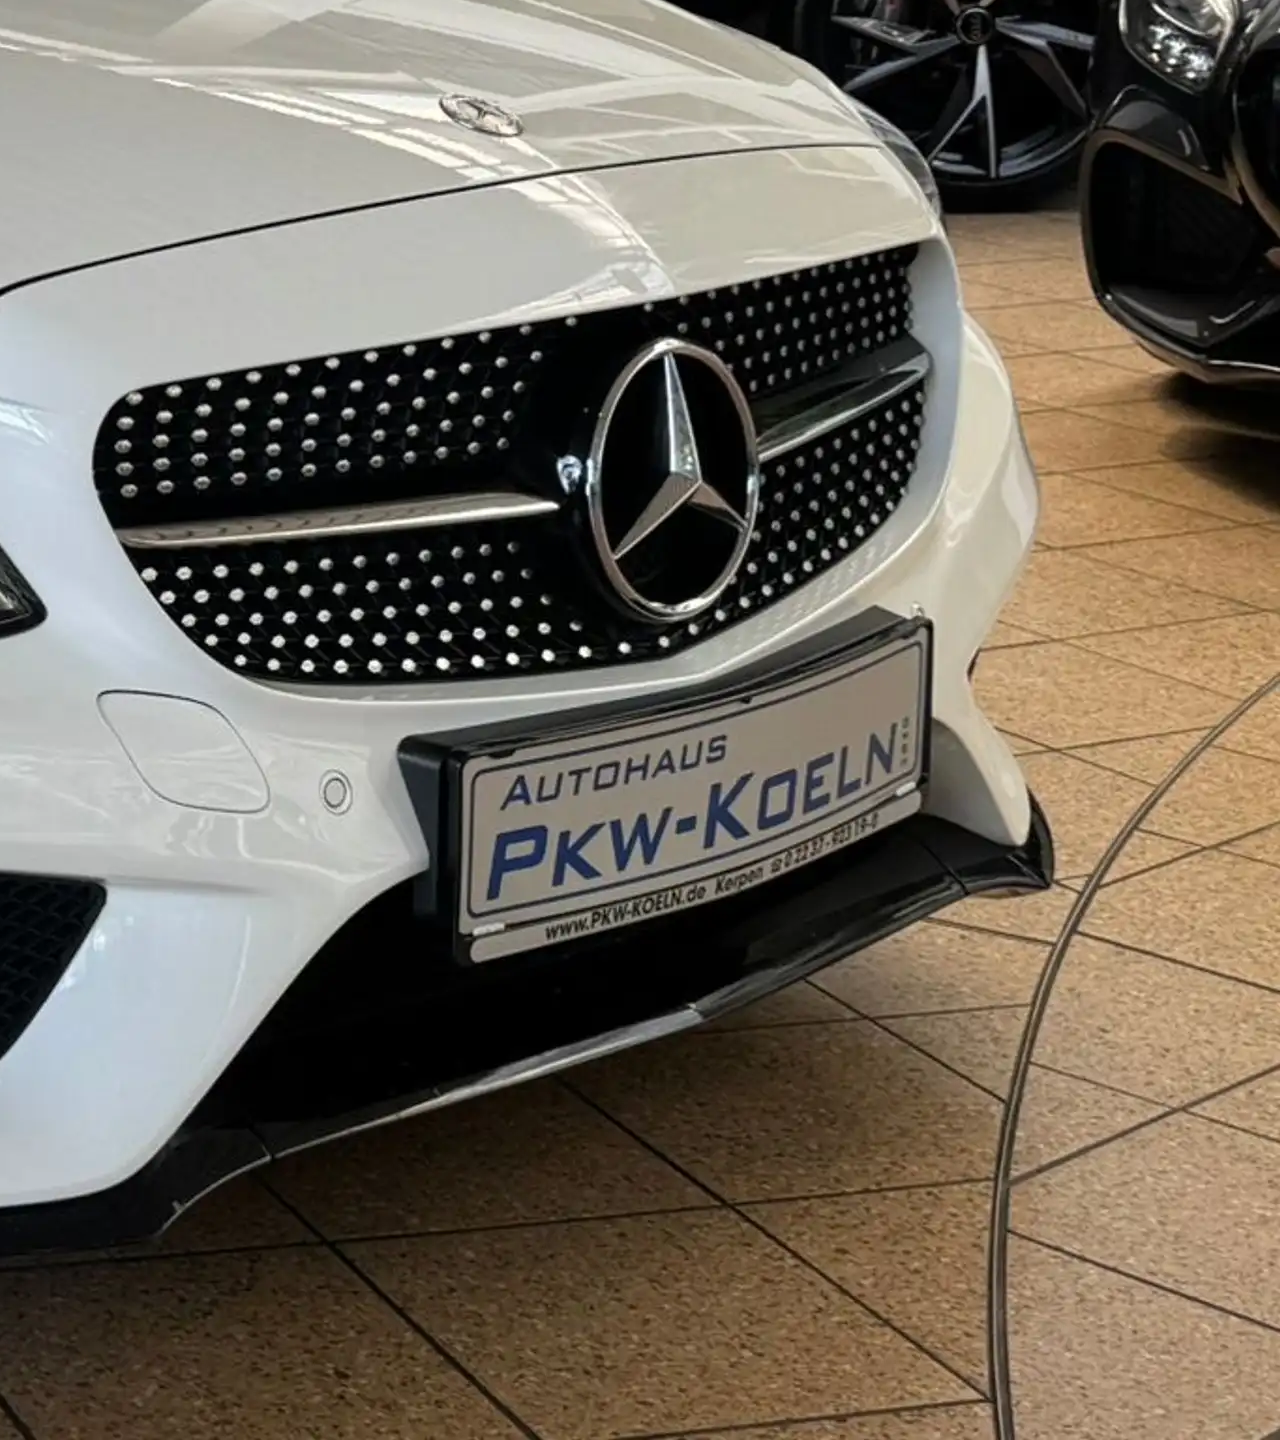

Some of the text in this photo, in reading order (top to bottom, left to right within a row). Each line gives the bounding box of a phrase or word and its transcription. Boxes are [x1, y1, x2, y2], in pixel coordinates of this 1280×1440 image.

[500, 734, 727, 810] AUTOHAUS
[487, 722, 898, 901] PKW-KOELN
[544, 885, 707, 941] www.PKW-KOELN.de
[715, 867, 764, 896] Kerpen
